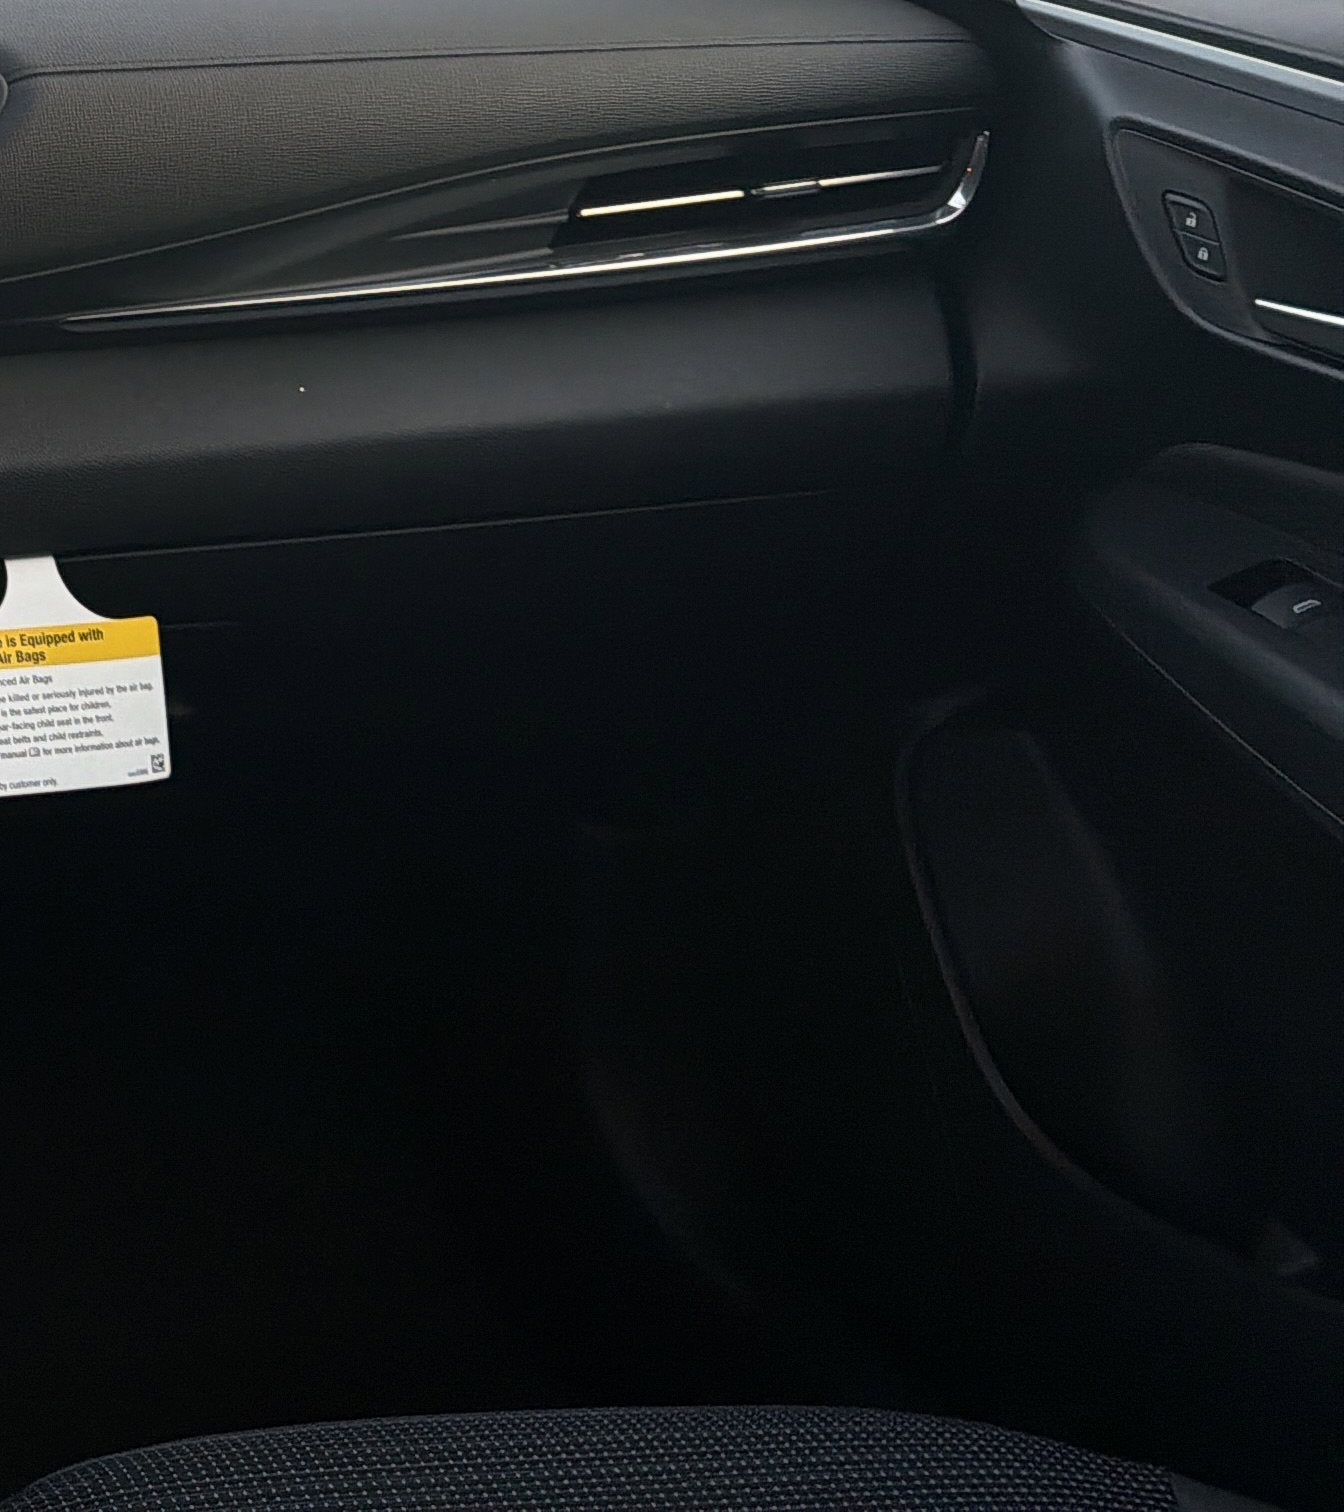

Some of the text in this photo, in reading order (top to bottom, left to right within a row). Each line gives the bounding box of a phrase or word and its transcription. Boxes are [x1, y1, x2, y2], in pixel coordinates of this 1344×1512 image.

[6, 635, 17, 647] is
[19, 630, 76, 648] Equipped
[78, 628, 104, 641] with
[15, 650, 46, 664] Bags
[19, 676, 30, 684] Air
[32, 675, 52, 685] Bags
[8, 693, 29, 702] killed
[42, 689, 76, 700] seriously
[78, 687, 104, 697] injured
[9, 708, 21, 716] the
[47, 705, 67, 715] place
[69, 703, 79, 711] for
[37, 719, 54, 728] child
[33, 733, 47, 742] and
[49, 732, 66, 741] child
[0, 749, 27, 759] manual
[43, 748, 52, 756] for
[54, 747, 73, 755] more
[74, 742, 113, 753] information
[9, 780, 41, 789] customer
